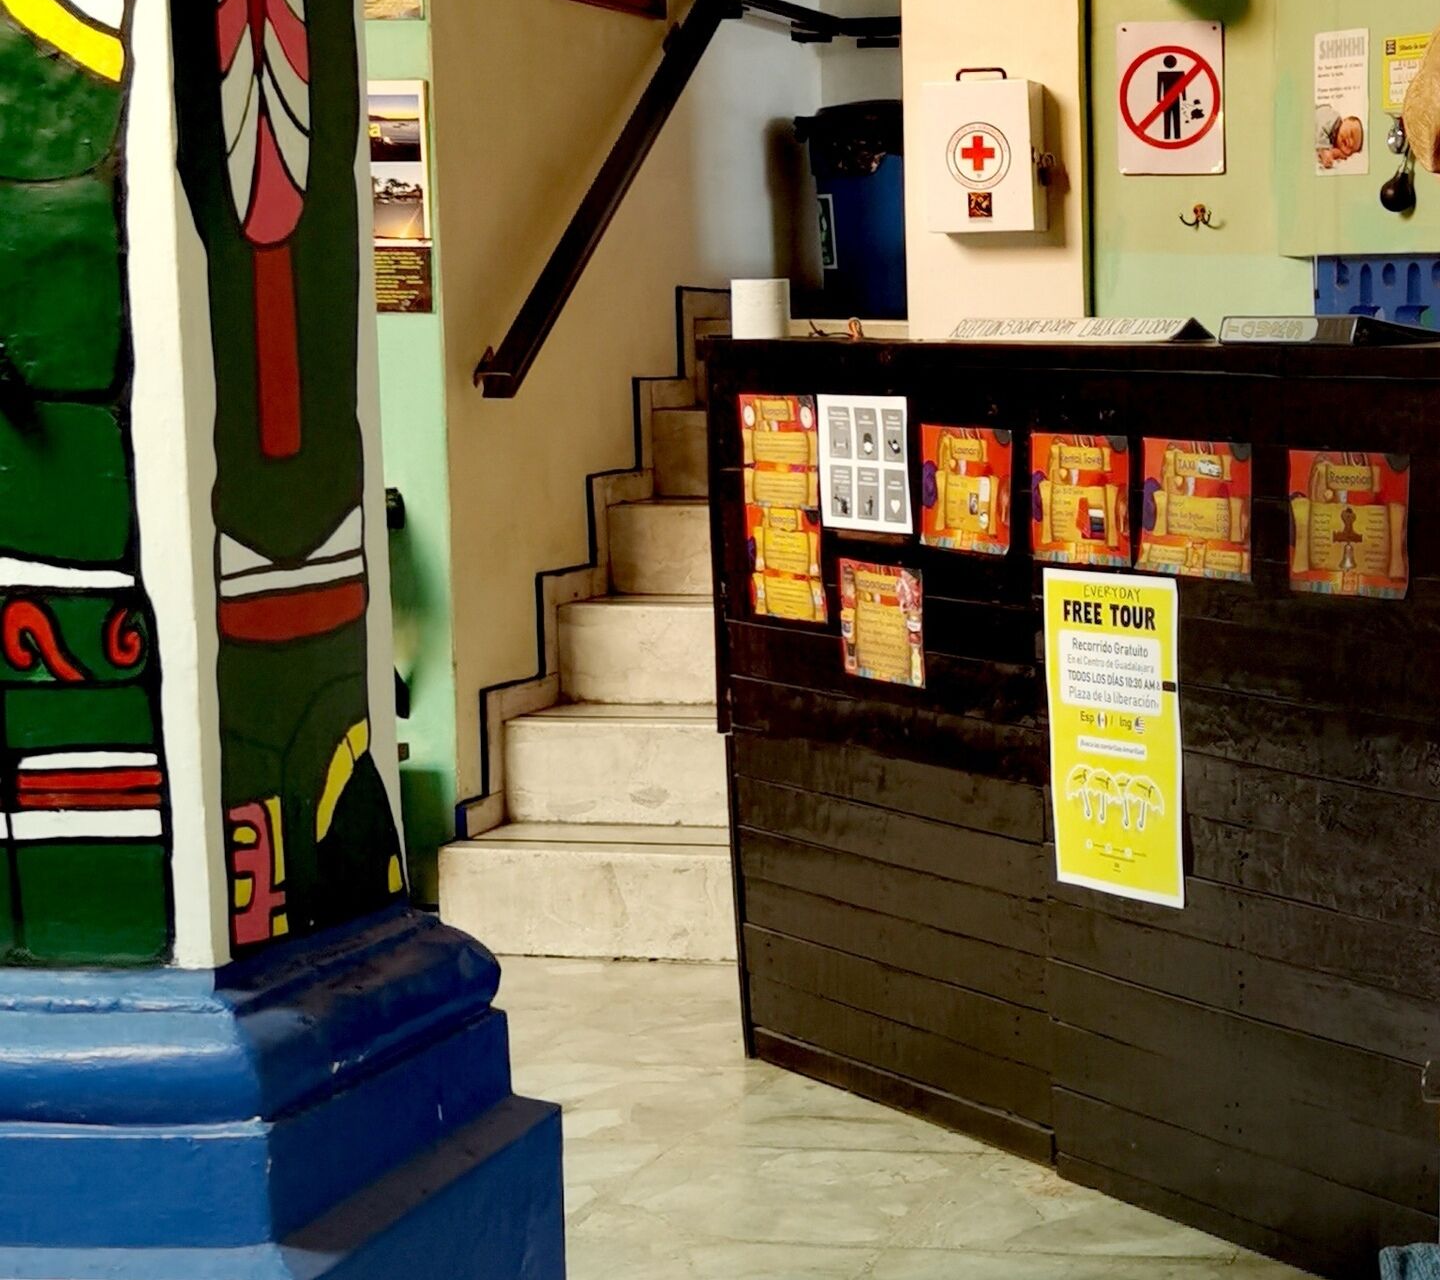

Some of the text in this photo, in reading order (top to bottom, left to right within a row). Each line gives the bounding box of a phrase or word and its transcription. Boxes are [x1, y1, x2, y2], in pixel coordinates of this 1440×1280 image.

[1177, 458, 1197, 470] TAXI
[1083, 584, 1141, 603] EVERYDAY
[1063, 599, 1156, 631] FREE TOUR
[1072, 637, 1149, 658] Recorrido Gratuito
[1083, 656, 1105, 668] Centro
[1105, 658, 1114, 669] de
[1068, 669, 1091, 683] TODOS
[1091, 672, 1106, 685] LOS
[1107, 672, 1125, 688] DÍAS
[1125, 677, 1143, 689] 10:30
[1068, 685, 1091, 700] Plaza
[1093, 689, 1103, 702] de
[1103, 690, 1112, 703] la
[1079, 710, 1095, 724] Esp
